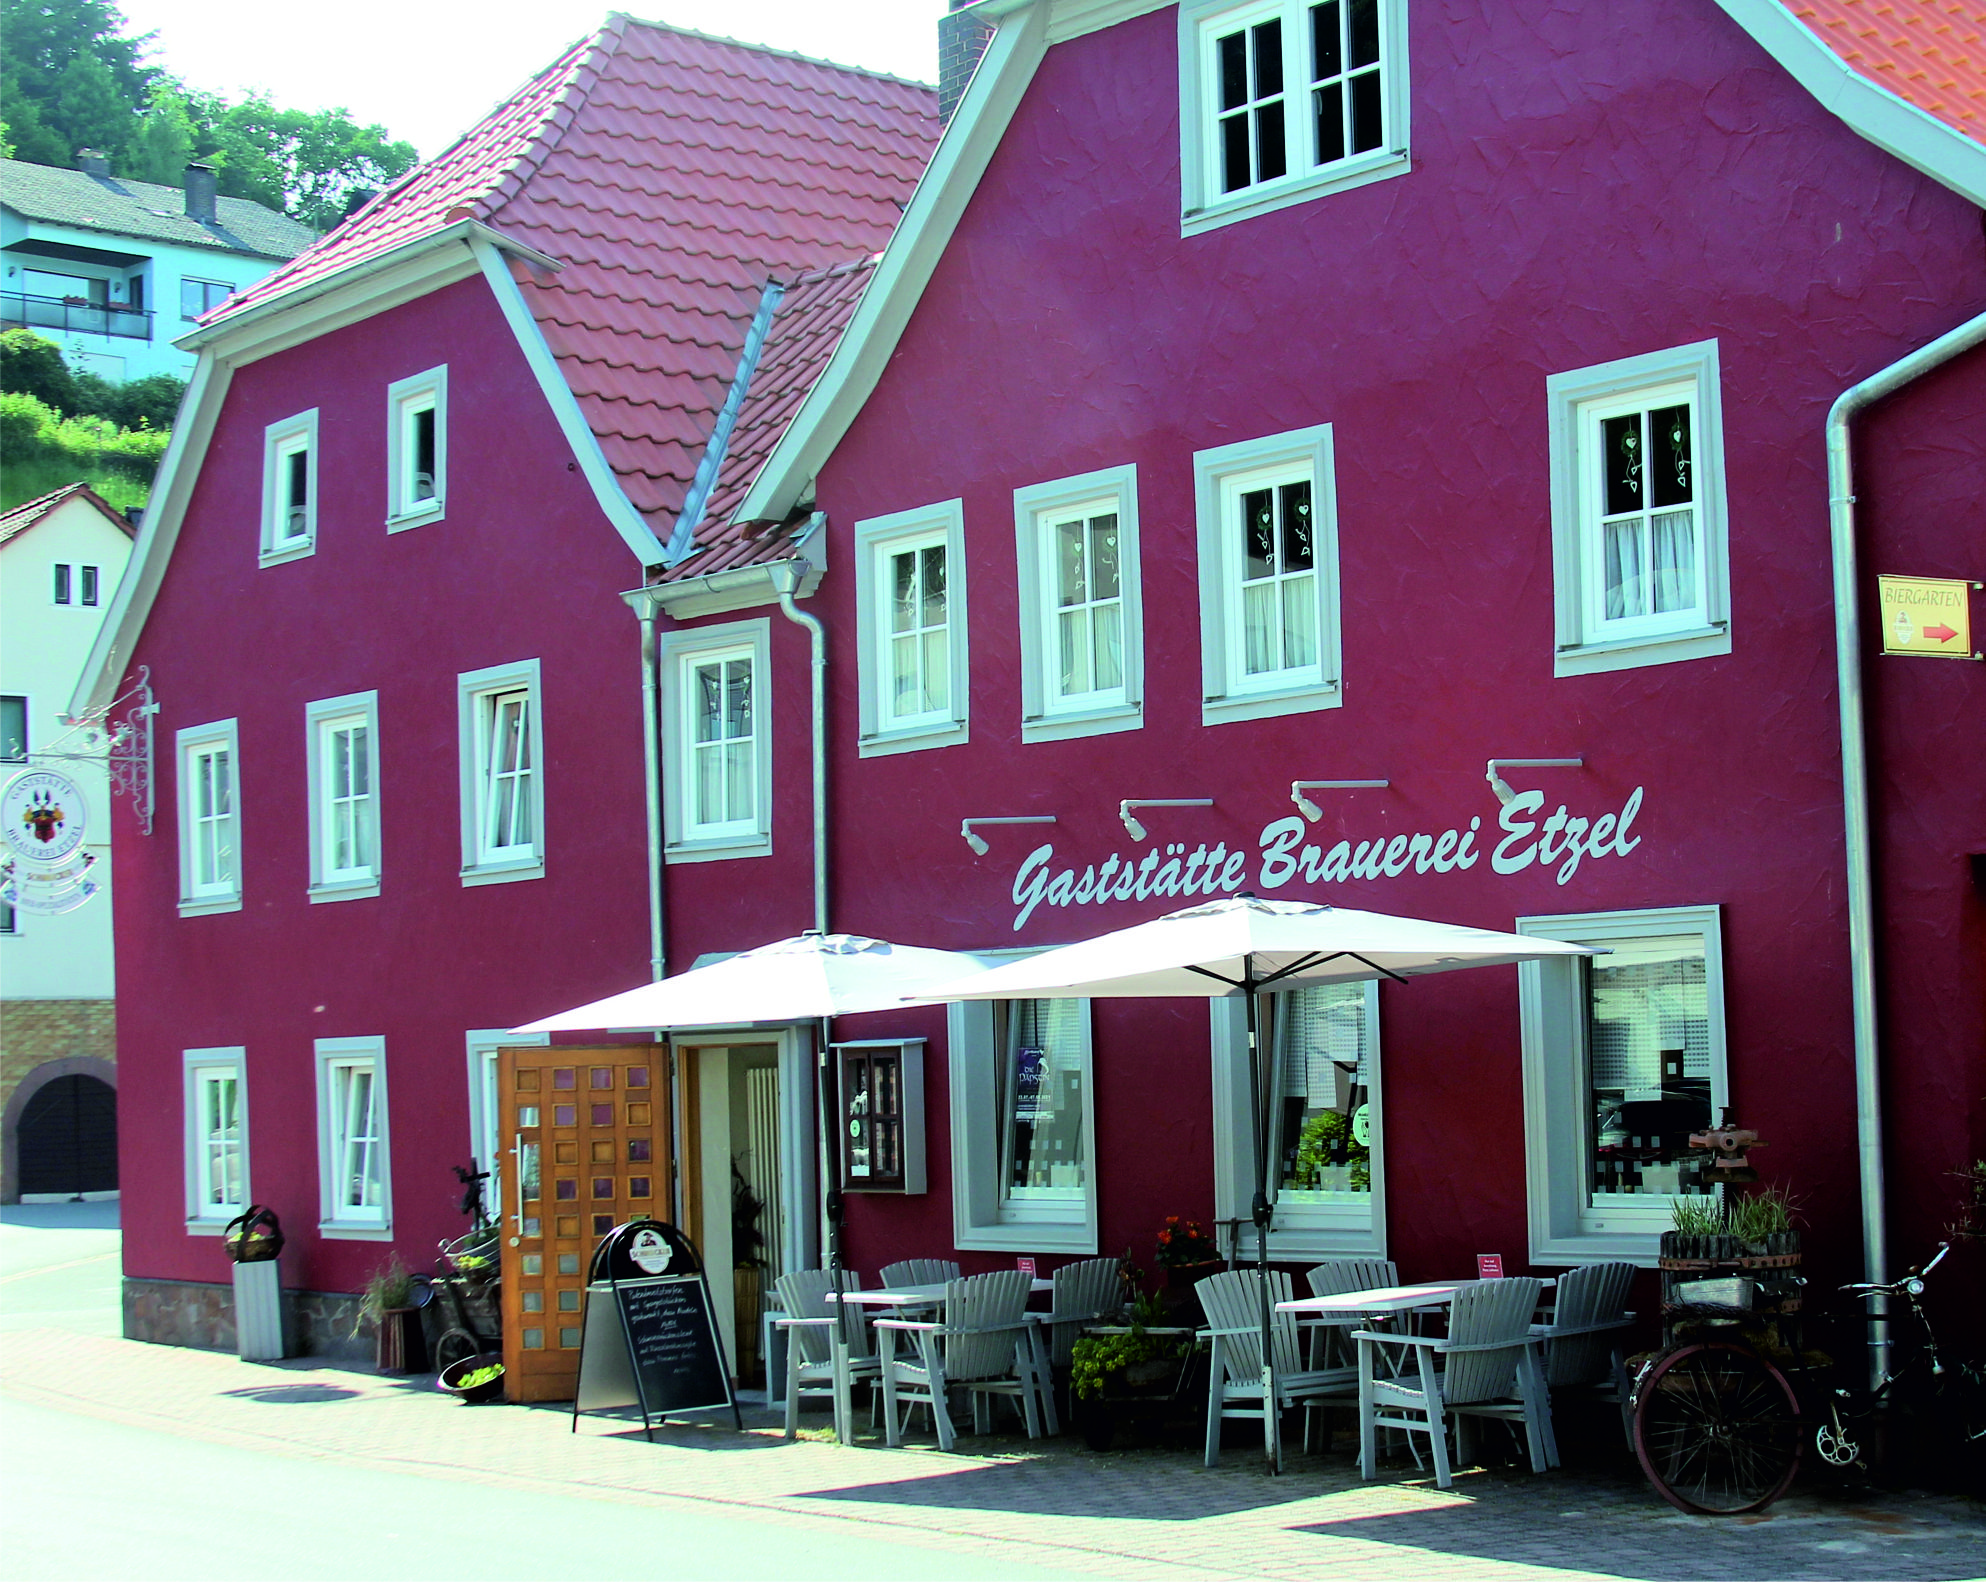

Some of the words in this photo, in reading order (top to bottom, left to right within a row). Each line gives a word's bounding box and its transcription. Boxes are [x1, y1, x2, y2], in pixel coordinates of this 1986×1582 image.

[1885, 587, 1963, 607] BIERGARTEN
[1011, 842, 1246, 931] Gaststätte
[1258, 816, 1481, 889] Brauerei
[1490, 786, 1643, 885] Etzel
